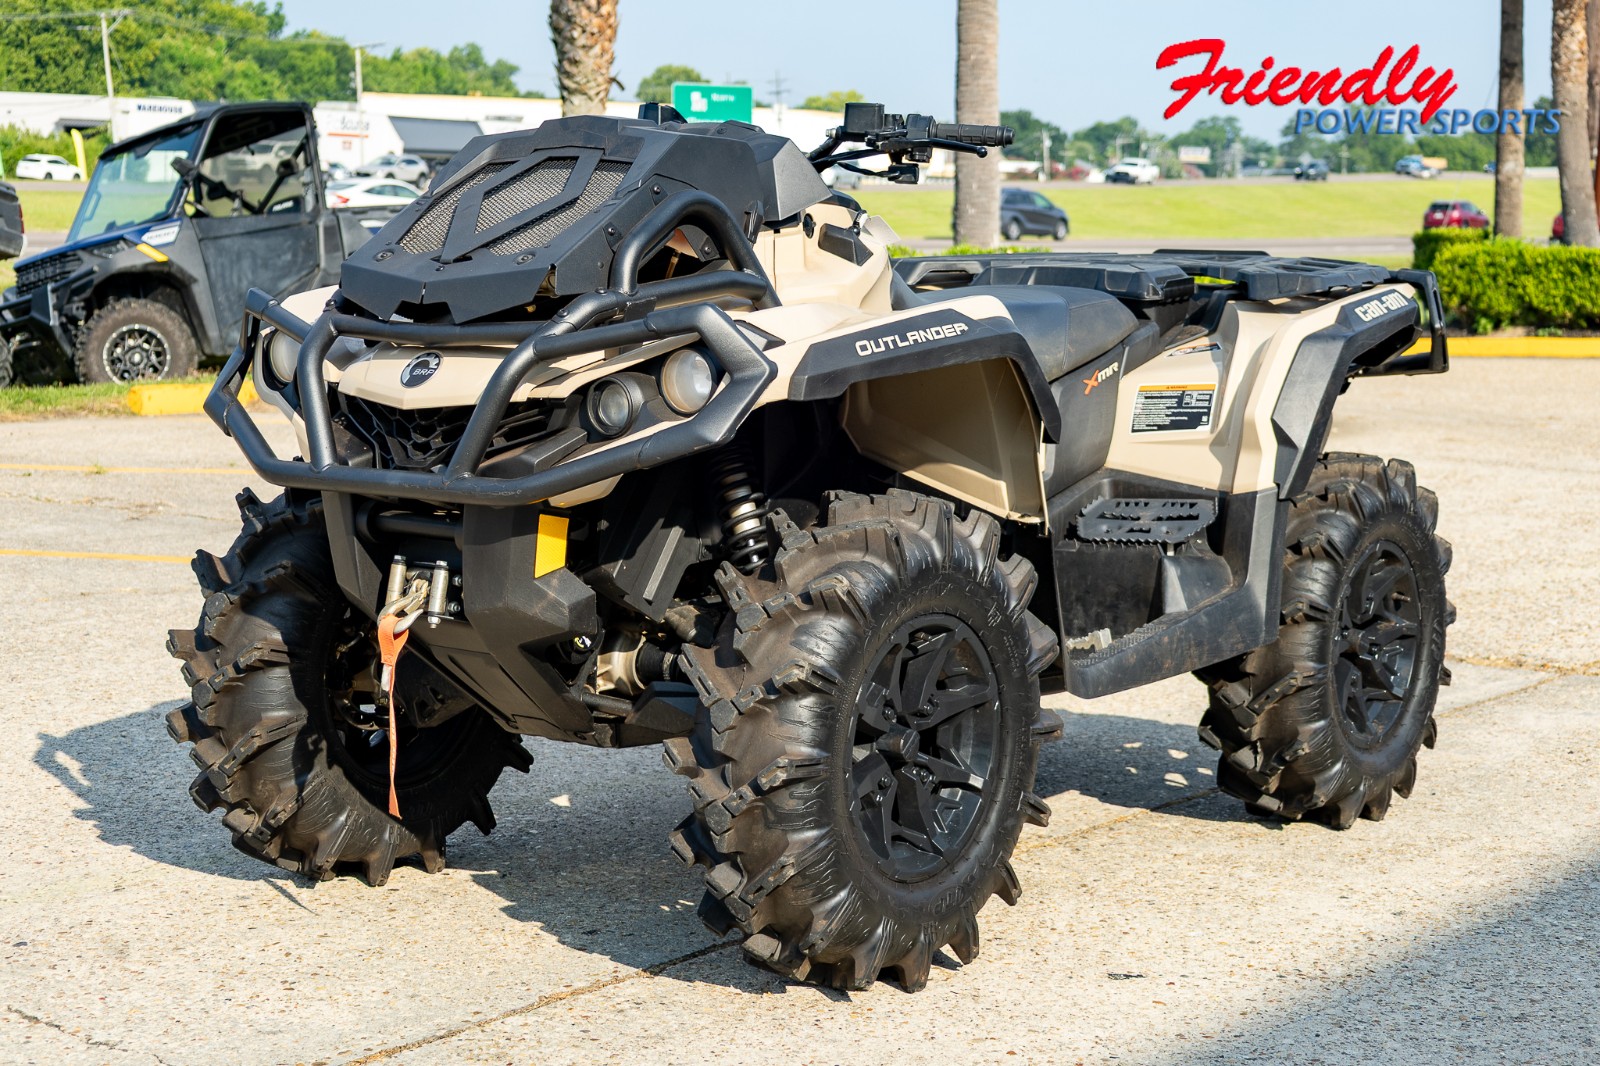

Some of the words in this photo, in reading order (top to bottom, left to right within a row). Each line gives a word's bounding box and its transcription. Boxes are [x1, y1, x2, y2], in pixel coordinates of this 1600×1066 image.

[137, 104, 183, 114] WAREHOUSE
[855, 322, 969, 357] OUTLANDER
[412, 368, 435, 376] BRP
